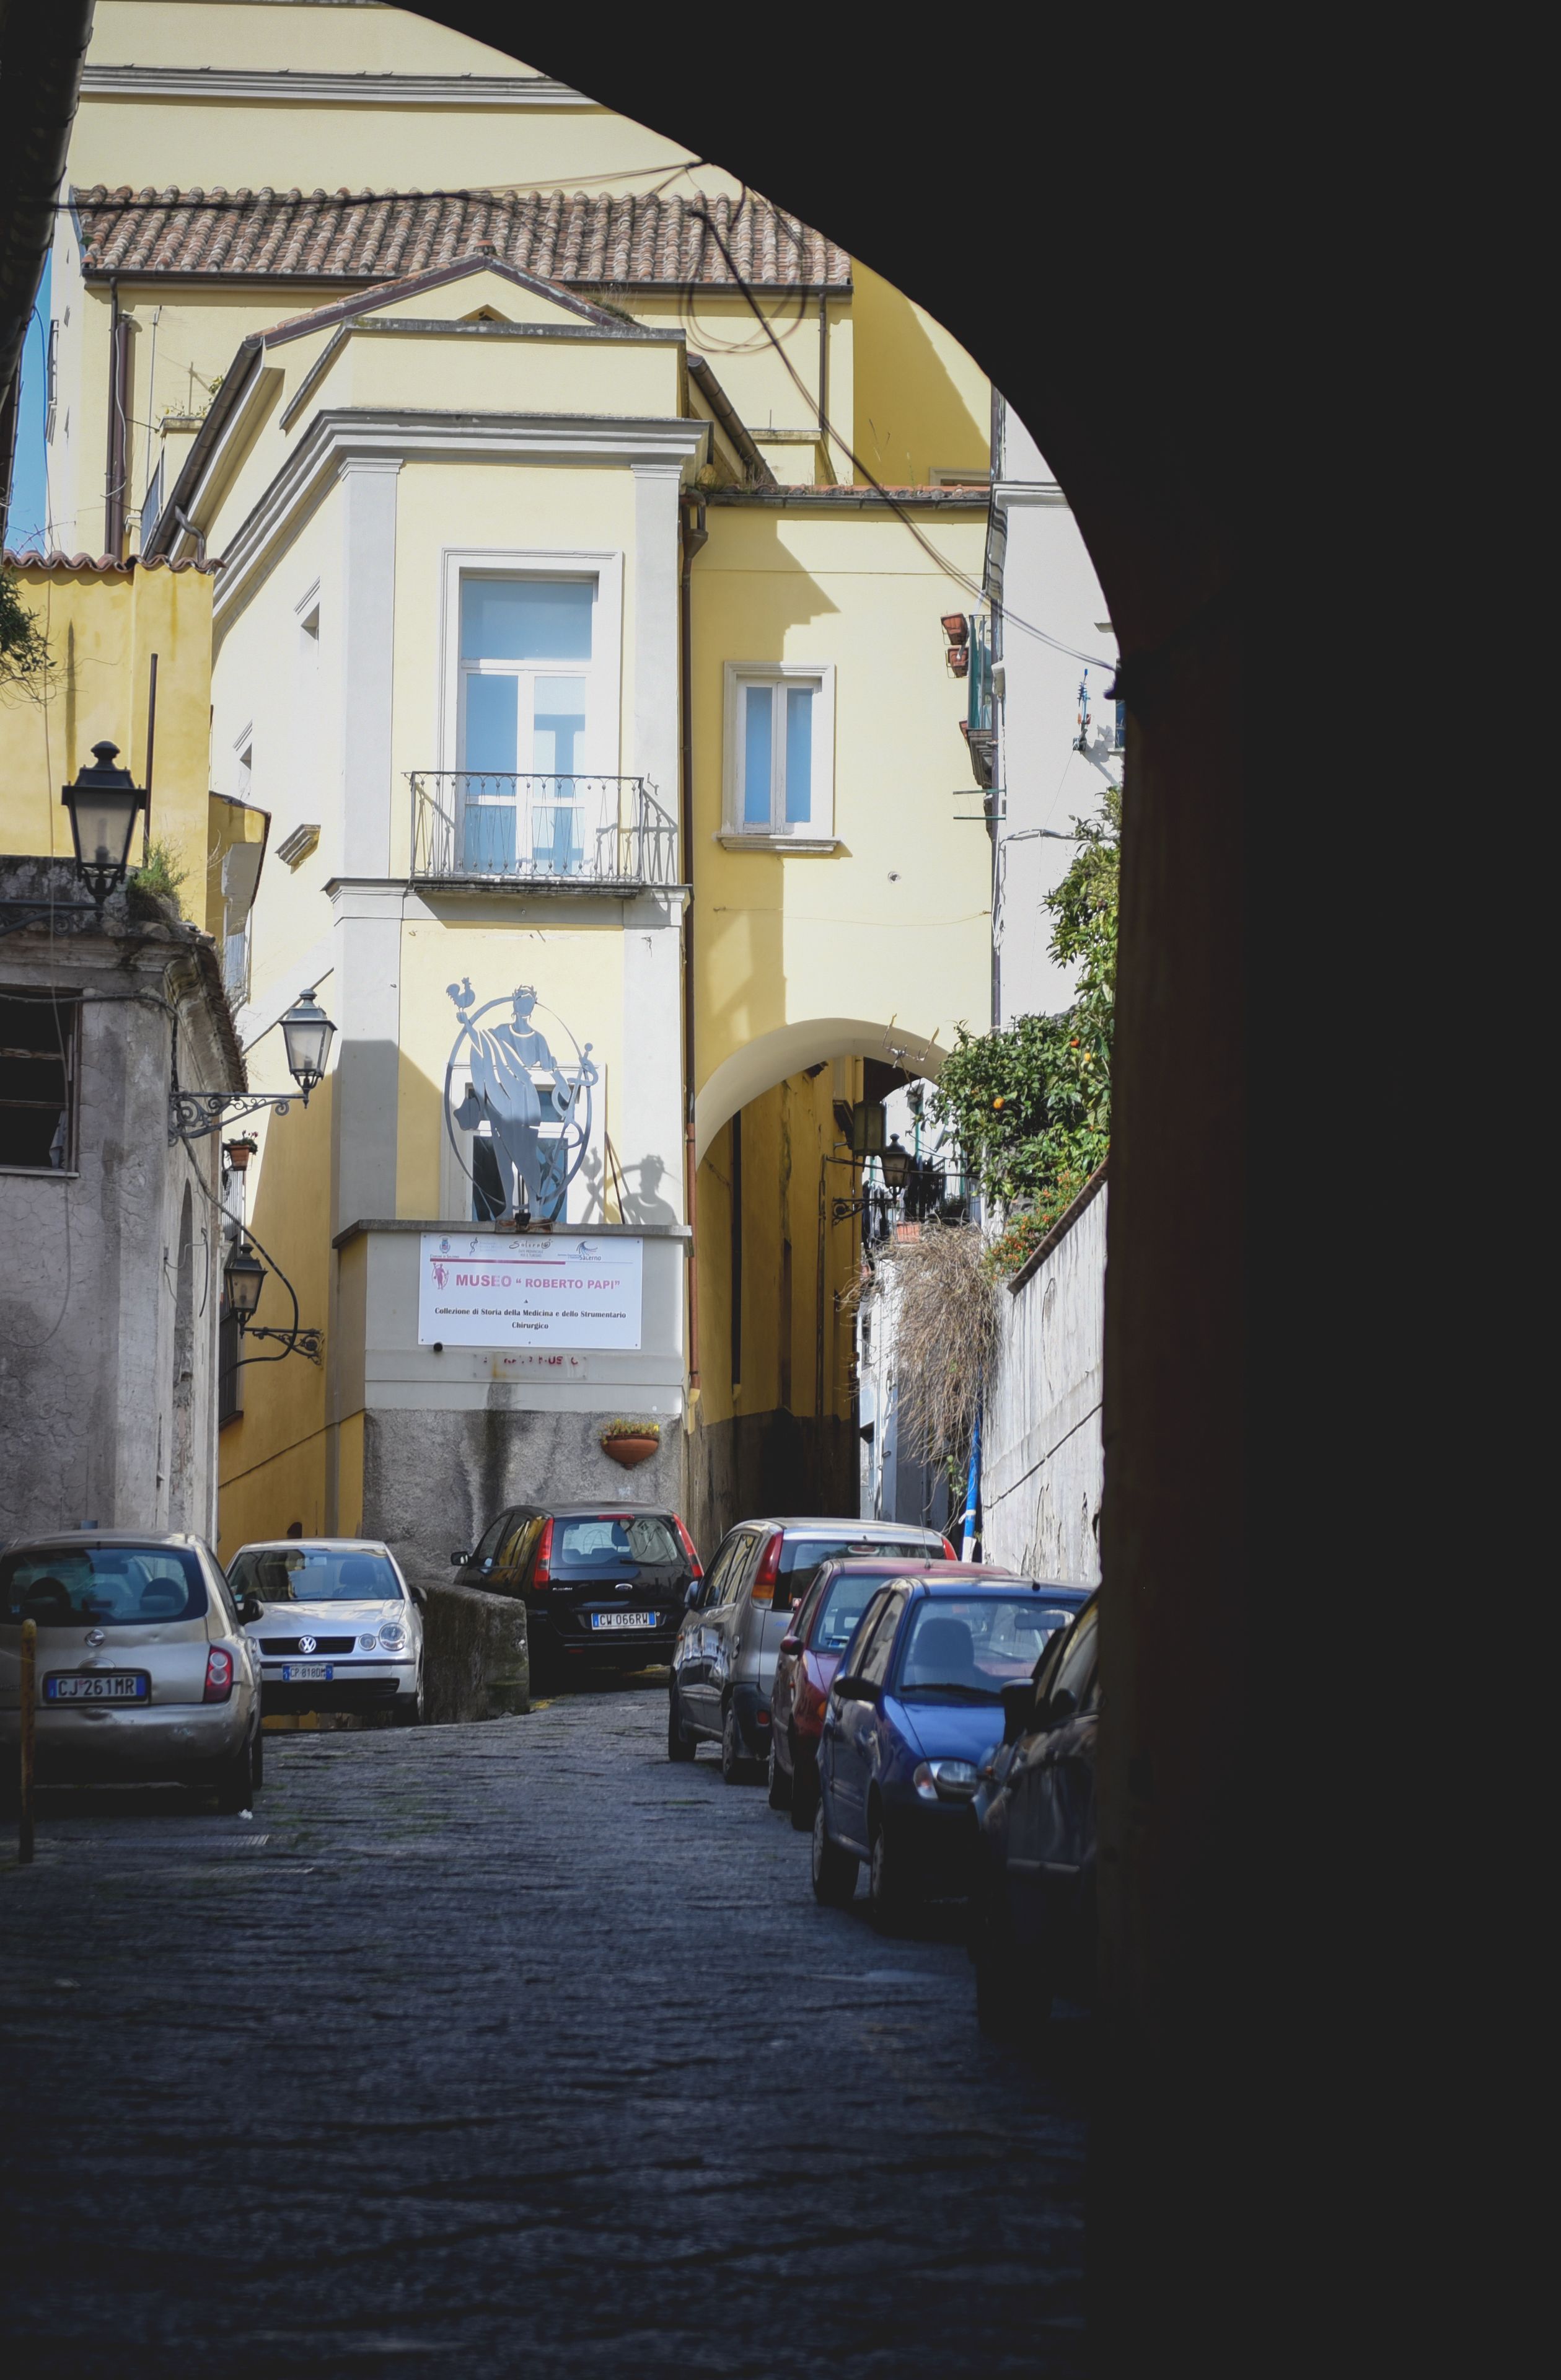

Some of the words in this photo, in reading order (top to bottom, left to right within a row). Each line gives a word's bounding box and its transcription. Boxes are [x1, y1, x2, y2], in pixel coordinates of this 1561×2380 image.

[455, 1274, 512, 1287] MUSEO
[525, 1278, 584, 1289] ROBERTO
[435, 1307, 470, 1315] Collezione
[481, 1308, 502, 1316] Storia
[522, 1309, 553, 1317] Medicina
[581, 1310, 627, 1318] Strumentario
[512, 1321, 549, 1331] Chirurgico
